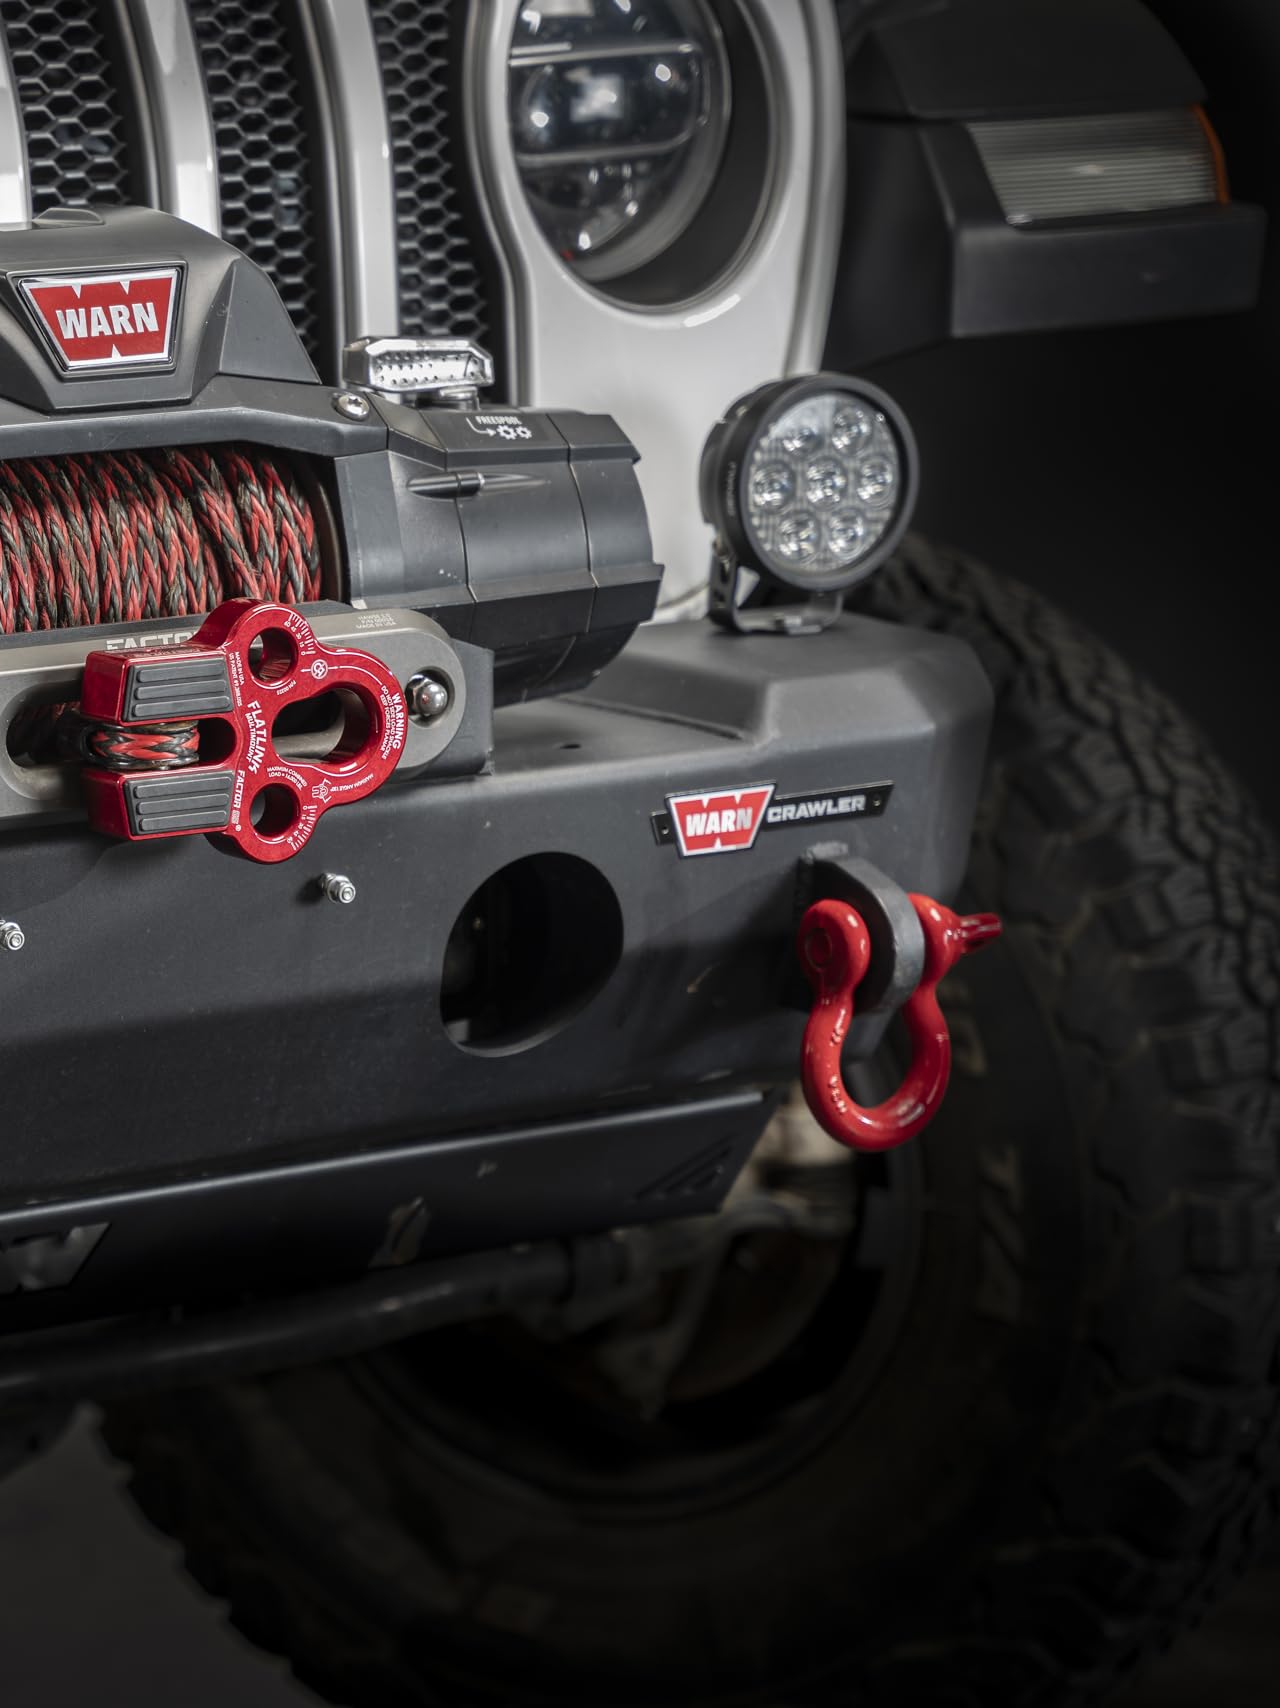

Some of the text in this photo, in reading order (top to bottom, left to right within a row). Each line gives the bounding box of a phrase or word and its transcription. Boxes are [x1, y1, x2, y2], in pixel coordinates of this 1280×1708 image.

[56, 302, 159, 339] WARN
[106, 631, 198, 650] FACTO
[381, 685, 389, 695] DO
[386, 694, 394, 706] NOT
[392, 692, 405, 749] WARNING
[245, 712, 256, 763] MULTIMOUNT
[247, 700, 267, 775] FLATLINK
[380, 729, 390, 752] PLANAR
[381, 735, 394, 760] SHACKLE
[267, 766, 288, 774] MAXIMUM
[233, 769, 246, 808] FACTOR
[685, 795, 867, 837] WARN CRAWLER
